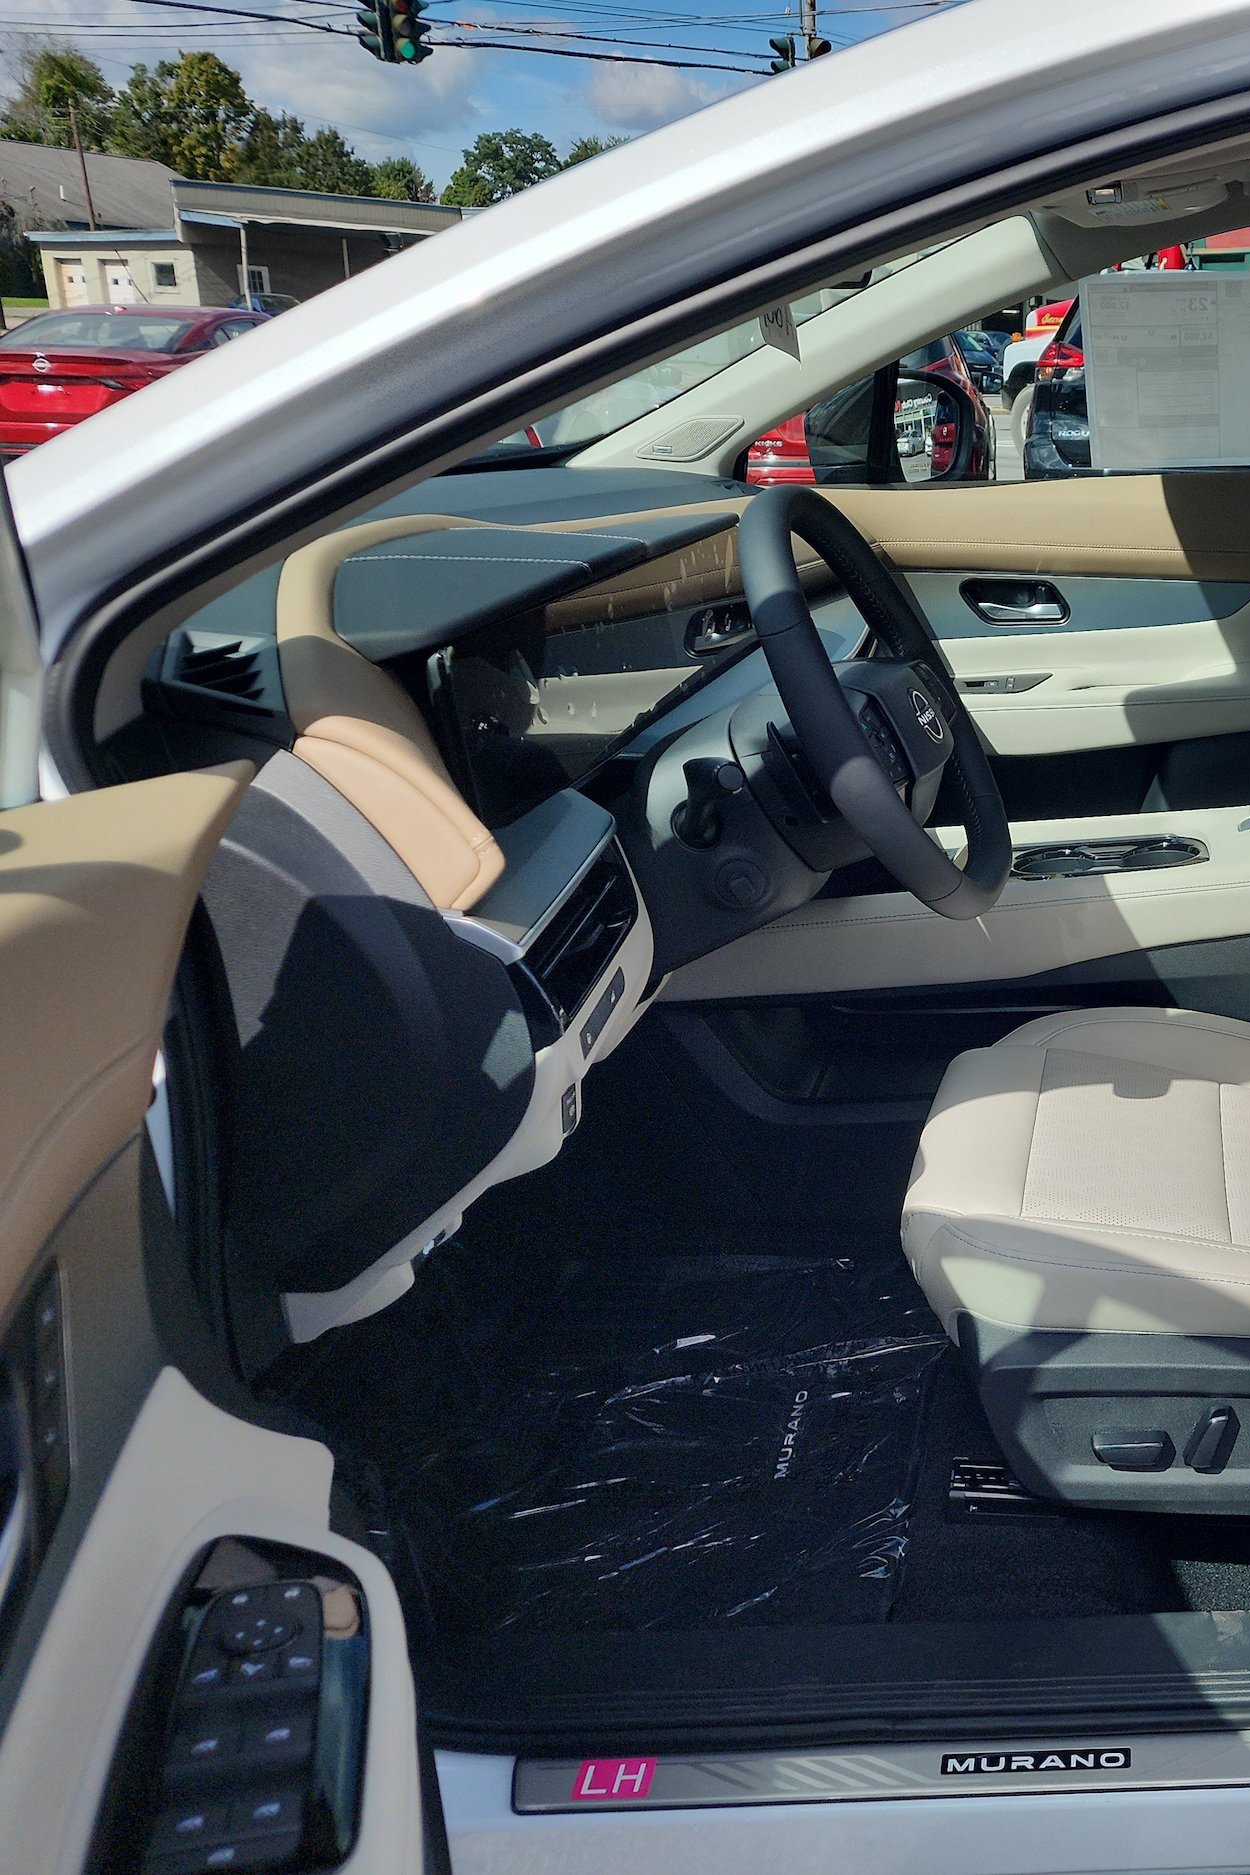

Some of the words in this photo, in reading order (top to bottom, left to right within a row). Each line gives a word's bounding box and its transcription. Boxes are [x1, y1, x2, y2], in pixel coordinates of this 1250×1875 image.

[1058, 429, 1090, 437] ROGU
[774, 1390, 808, 1479] MURANO
[946, 1752, 1126, 1772] MURANO
[580, 1762, 647, 1795] LH
